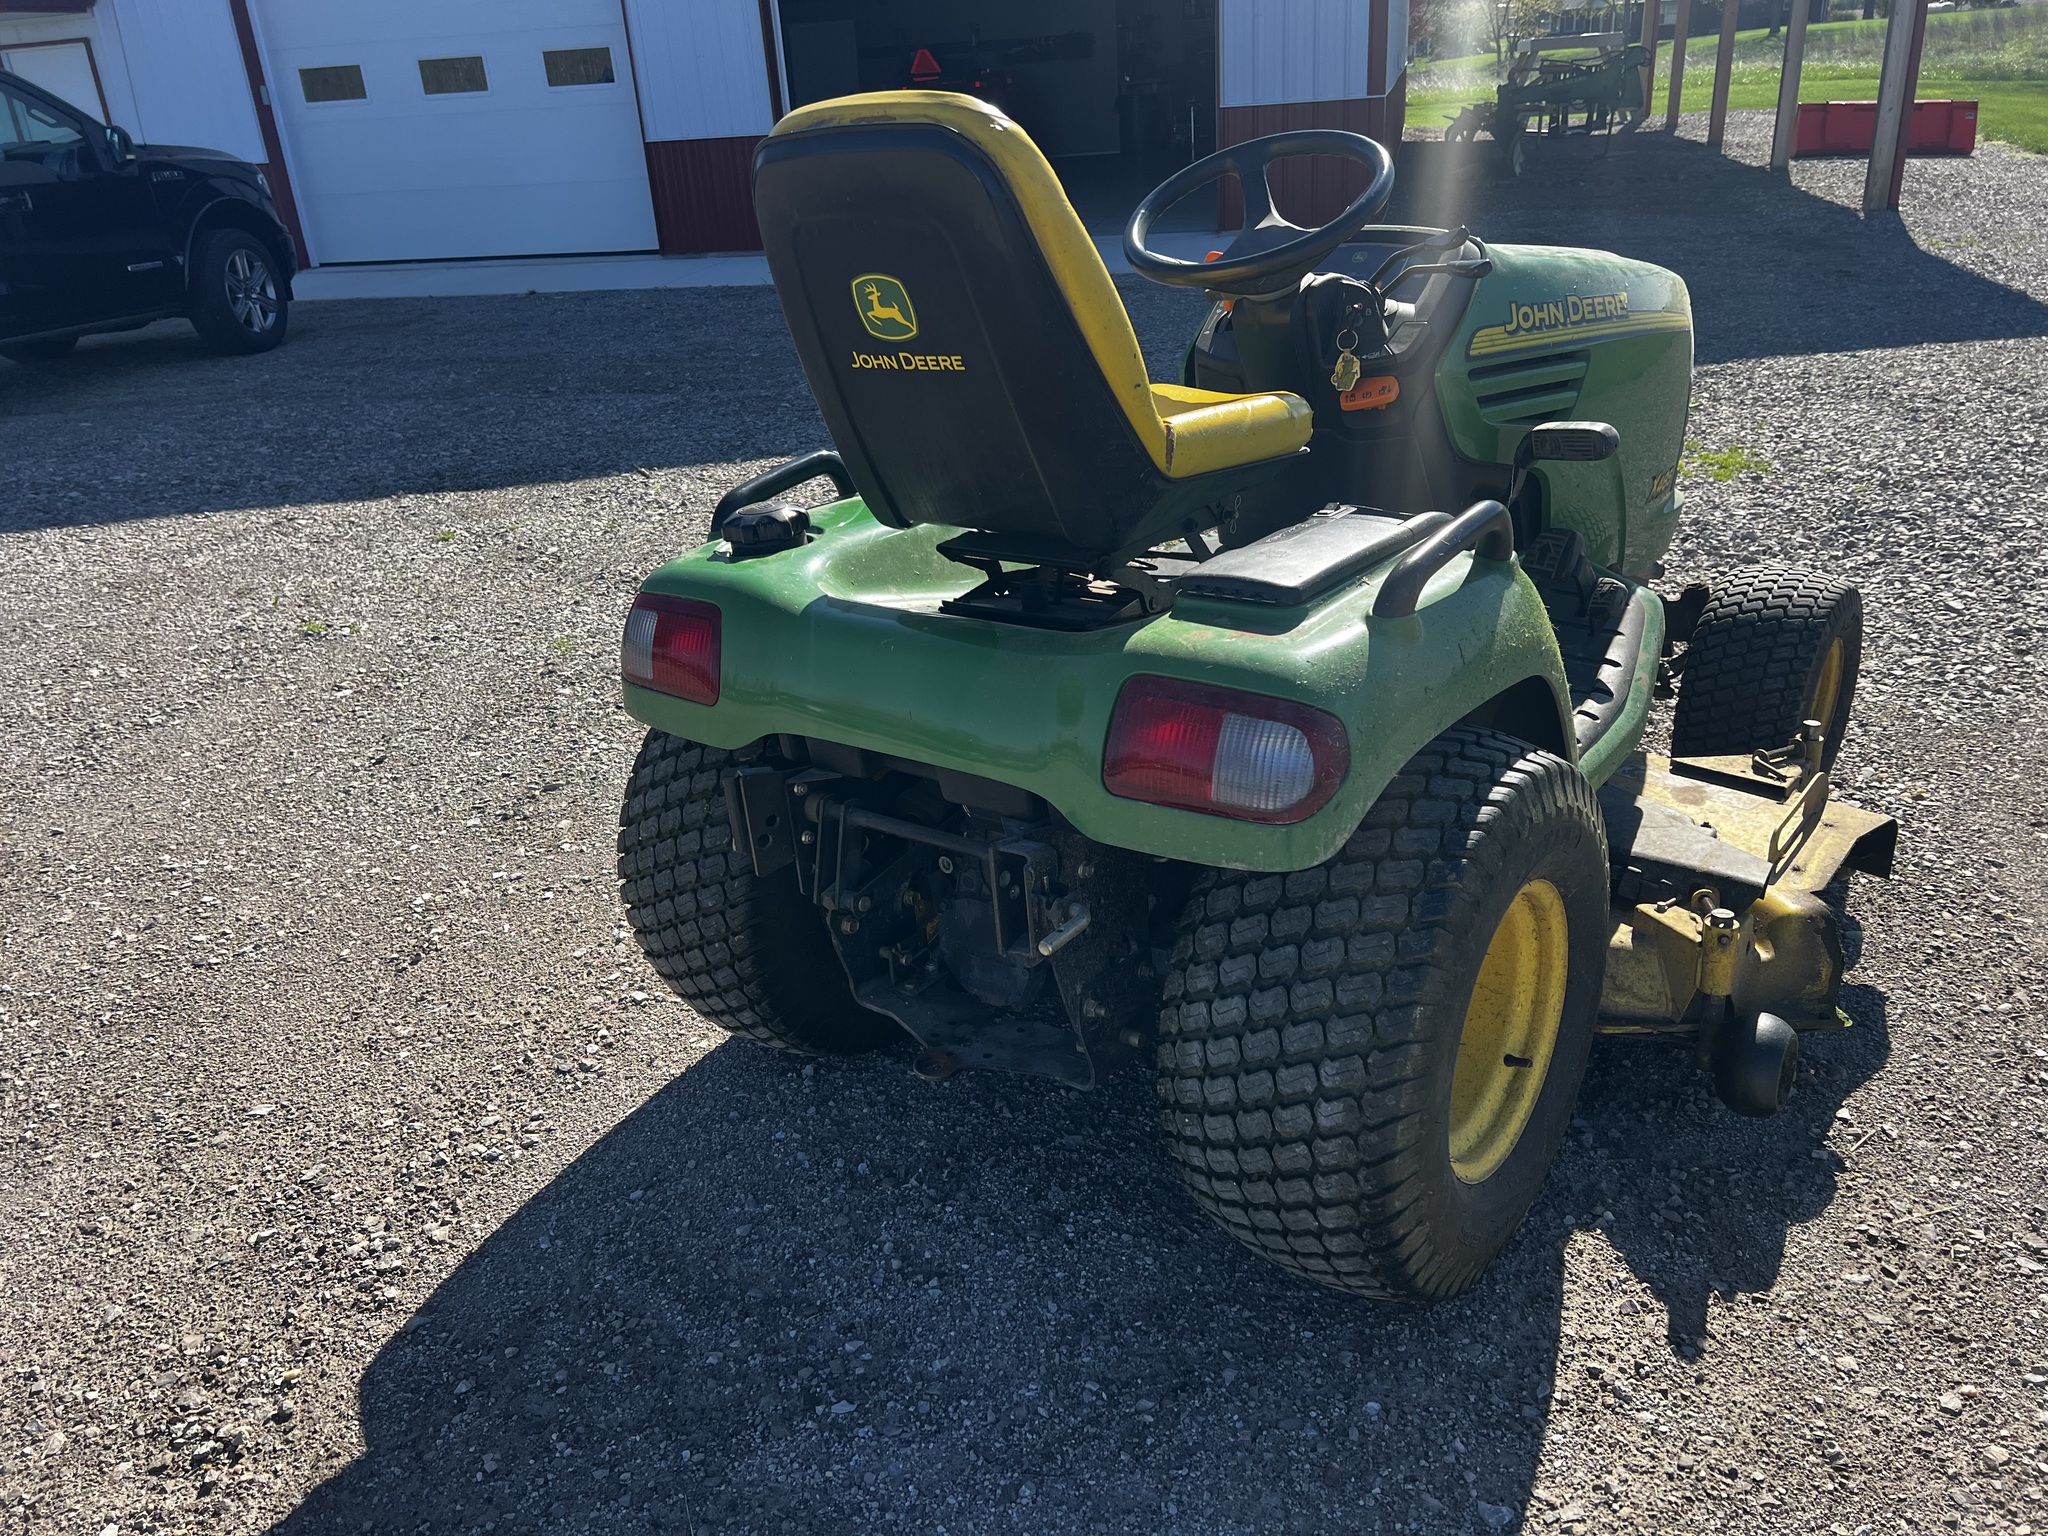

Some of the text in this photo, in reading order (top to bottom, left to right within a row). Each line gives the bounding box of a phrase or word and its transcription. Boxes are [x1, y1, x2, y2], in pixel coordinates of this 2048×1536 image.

[1504, 293, 1628, 332] JOHN DEERE
[851, 350, 966, 371] JOHN DEERE
